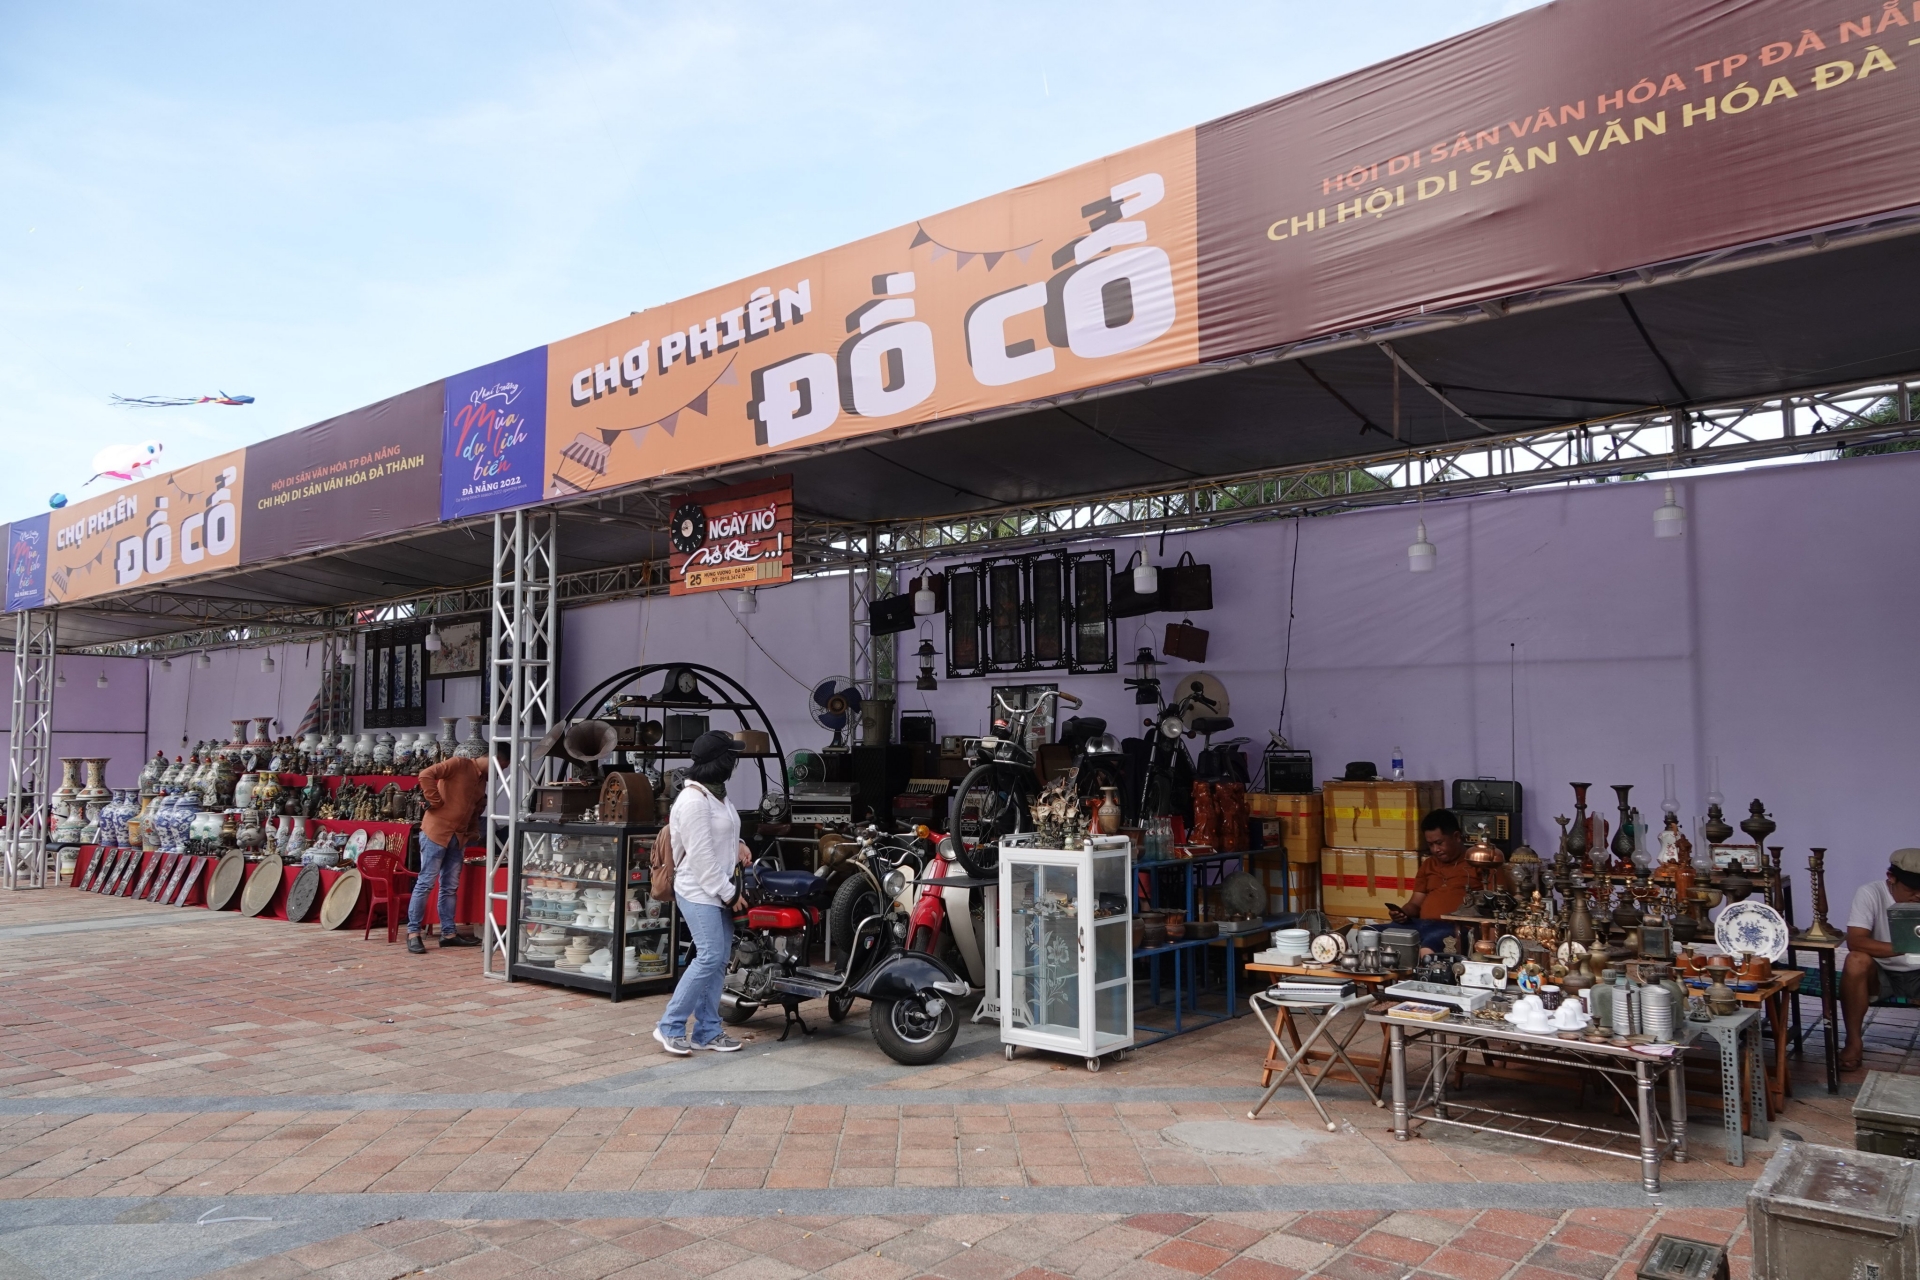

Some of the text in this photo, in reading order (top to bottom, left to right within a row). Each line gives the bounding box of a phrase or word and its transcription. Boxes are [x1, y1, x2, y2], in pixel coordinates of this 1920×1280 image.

[1322, 163, 1378, 195] HỘI
[1388, 150, 1420, 176] DI
[1430, 126, 1500, 163] SẢN
[1508, 100, 1585, 138] VĂN
[1598, 73, 1687, 114] HÓA
[1694, 53, 1748, 84] TP
[1758, 29, 1826, 67] ĐÀ
[1267, 45, 1897, 241] CHI HỘI DI SẢN VĂN HÓA ĐÀ
[757, 172, 1177, 448] ĐỒ CỔ
[571, 279, 811, 402] CHỢ PHIÊN
[454, 403, 519, 457] Mùa
[463, 419, 527, 461] du lịch
[257, 454, 424, 510] CHI HỘI DI SẢN VĂN HÓA ĐÀ THÀNH
[271, 444, 400, 491] HỘI DI SẢN VĂN HÓA TP ĐÀ NẴNG
[462, 476, 521, 496] ĐÀ NẴNG 2022
[473, 455, 511, 480] biển
[57, 494, 137, 547] CHỢ PHIÊN
[117, 466, 237, 586] ĐỒ CỔ
[709, 511, 749, 540] NGÀY
[690, 574, 701, 586] 25
